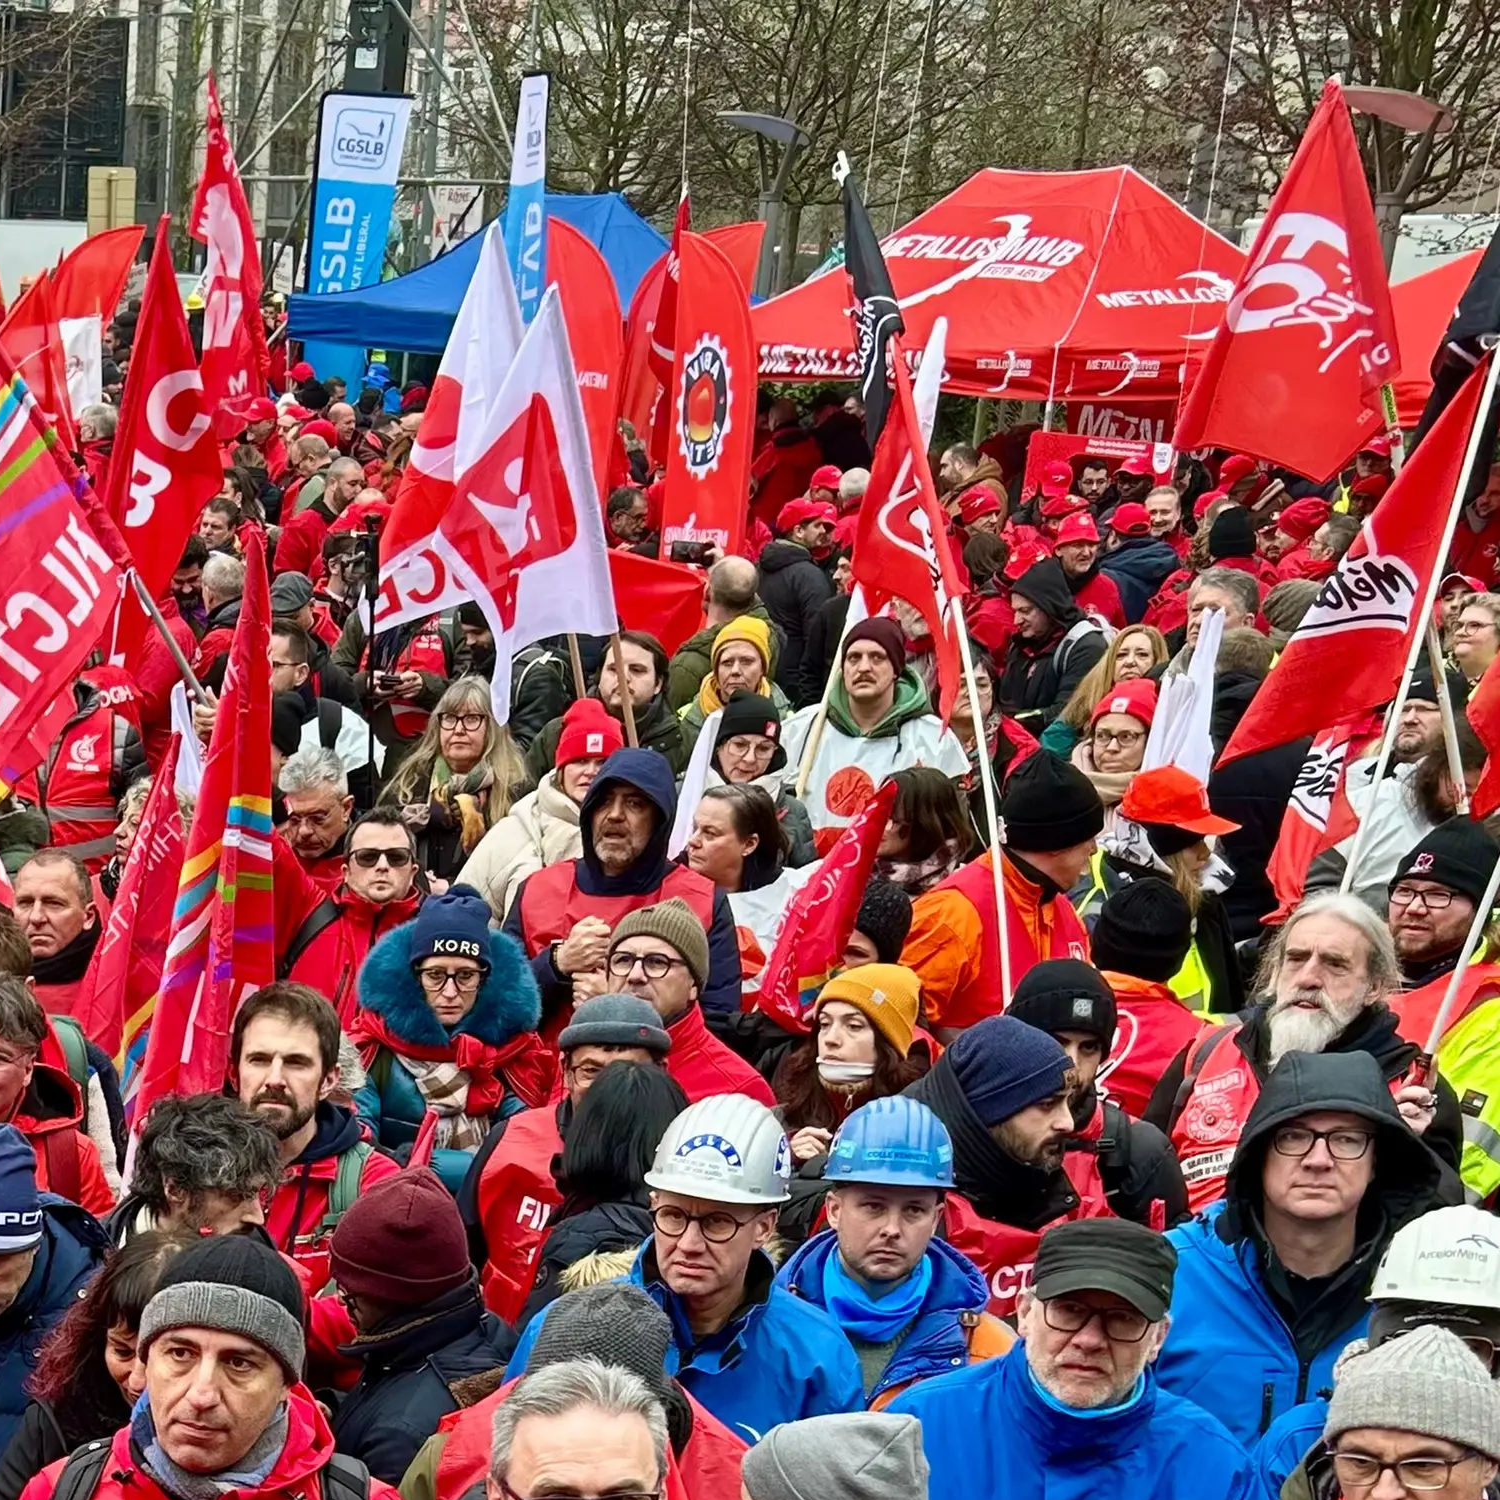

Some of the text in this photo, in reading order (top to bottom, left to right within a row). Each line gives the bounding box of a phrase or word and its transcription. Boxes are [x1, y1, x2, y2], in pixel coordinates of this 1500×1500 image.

[337, 137, 384, 156] CGSLB
[432, 938, 481, 957] KORS
[1418, 1247, 1489, 1263] ArcelorMittal
